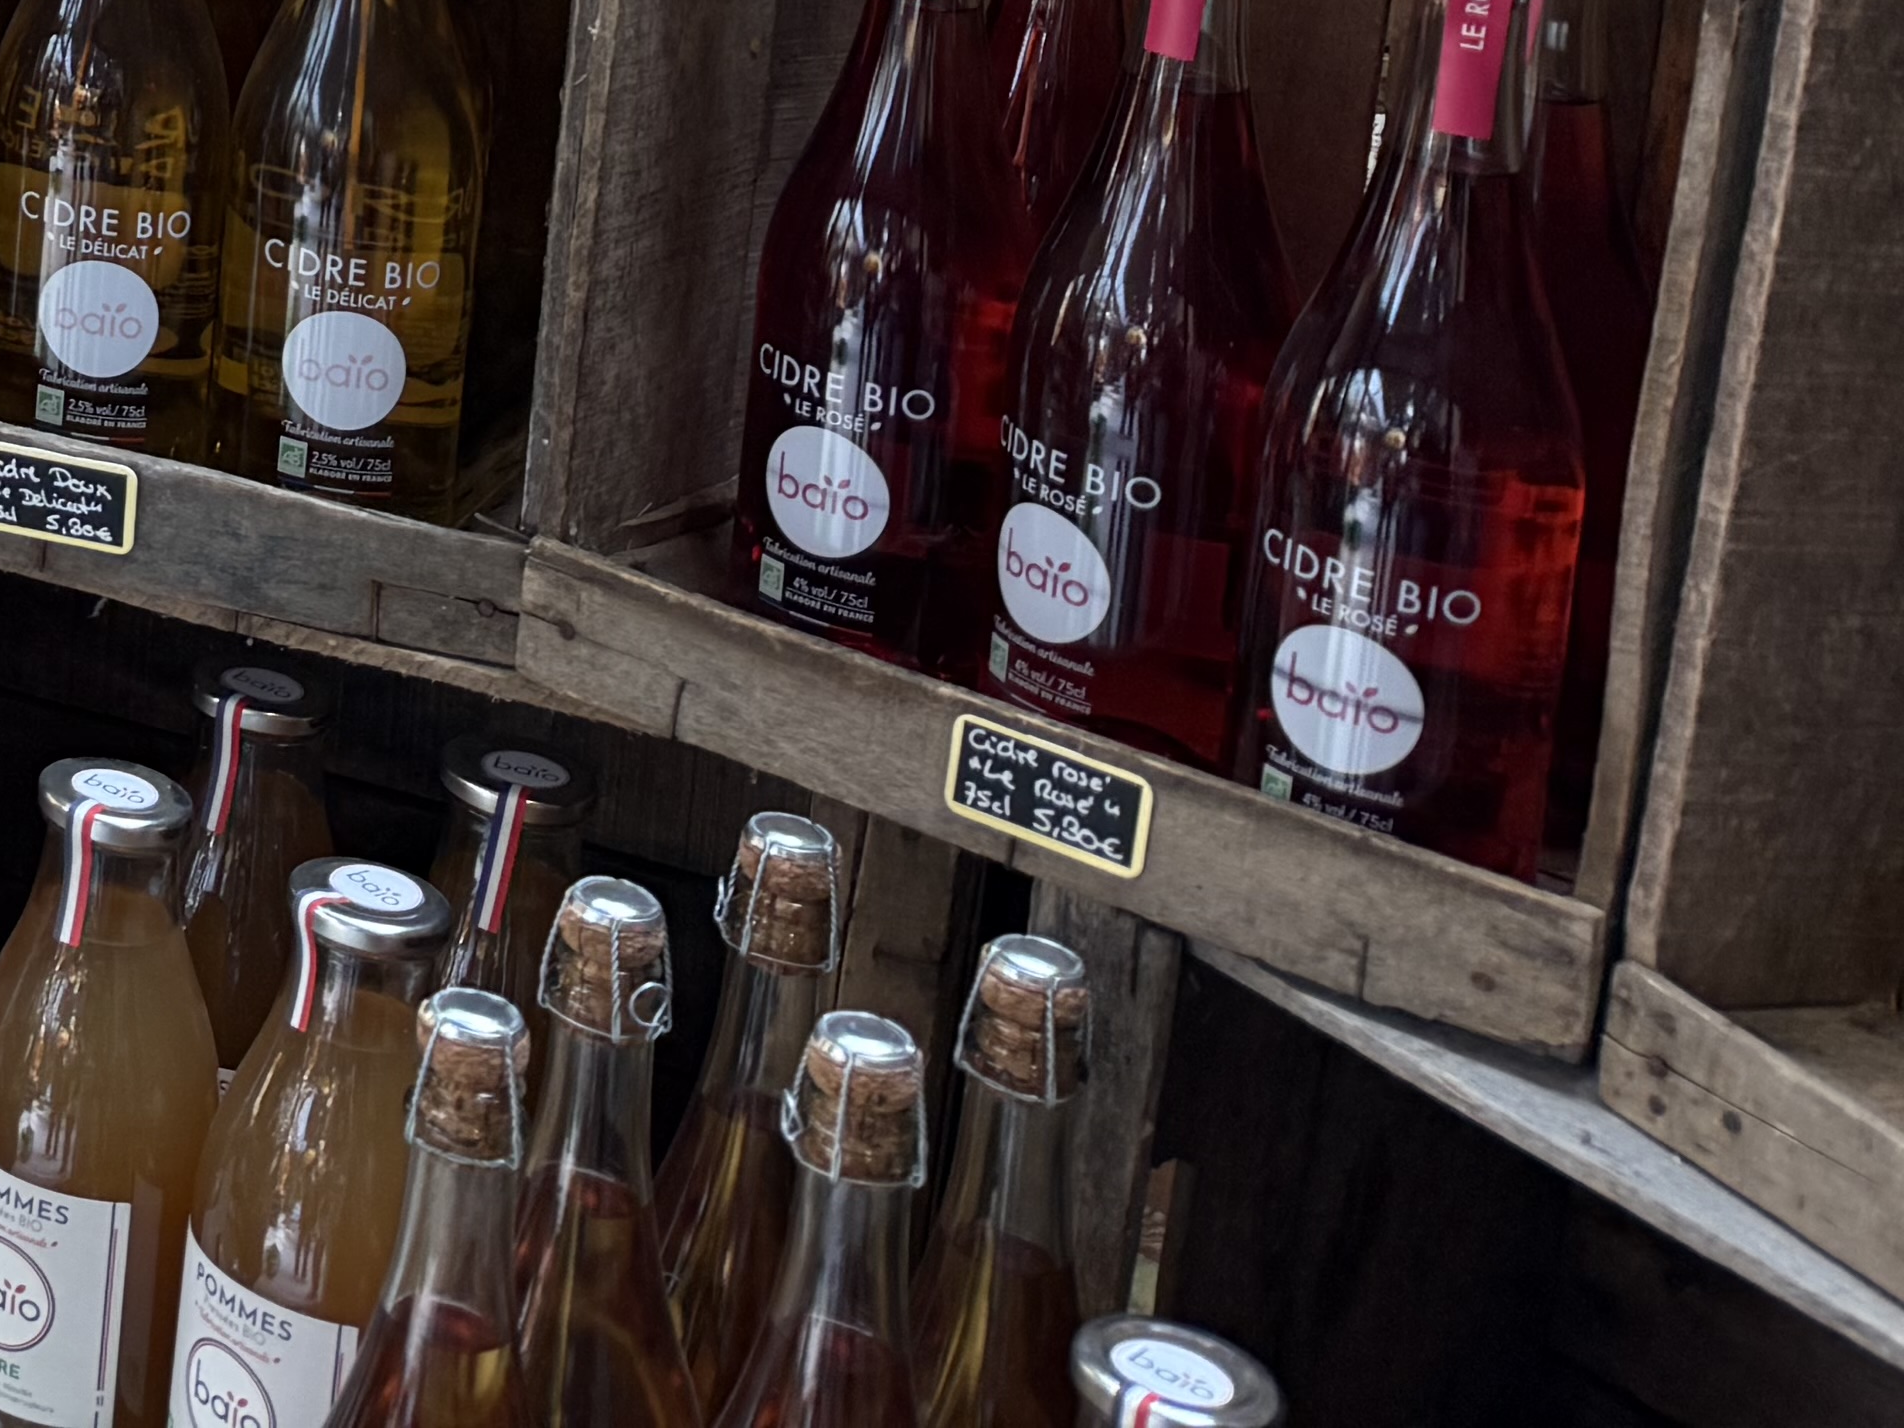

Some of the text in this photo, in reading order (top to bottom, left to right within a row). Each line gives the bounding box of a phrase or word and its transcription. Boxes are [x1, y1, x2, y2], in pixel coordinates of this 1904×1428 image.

[1460, 24, 1487, 51] LE
[21, 191, 191, 239] CIDRE BIO
[59, 234, 149, 260] LE DÉLICAT
[264, 238, 441, 289] CIDRE BIO
[54, 288, 143, 340] baïo
[304, 284, 397, 311] LE DÉLICAT
[298, 338, 389, 392] baïo
[760, 343, 936, 420] CIDRE BIO
[122, 405, 146, 418] 75cl
[794, 398, 865, 432] LE ROSÉ
[49, 467, 112, 500] Doux
[366, 458, 392, 471] 75cl
[1000, 414, 1162, 509] CIDRE BIO
[777, 450, 870, 521] baïo
[1021, 472, 1087, 517] LE ROSÉ
[762, 536, 877, 586] Fabrication artisanale
[1005, 527, 1090, 607] baïo
[1263, 528, 1482, 626] CIDRE BIO
[838, 608, 874, 624] FRANCE
[840, 590, 868, 610] 75cl
[1311, 593, 1399, 637] LE ROSÉ
[1056, 677, 1086, 700] 75cl
[1286, 651, 1400, 734] baïo
[492, 753, 560, 784] baïo
[968, 728, 1038, 768] Cidre
[81, 772, 146, 806] baïo
[964, 781, 1124, 860] 75cl 5,30€
[344, 868, 401, 907] baïo
[196, 1262, 293, 1342] POMMES
[1127, 1346, 1215, 1401] baïo
